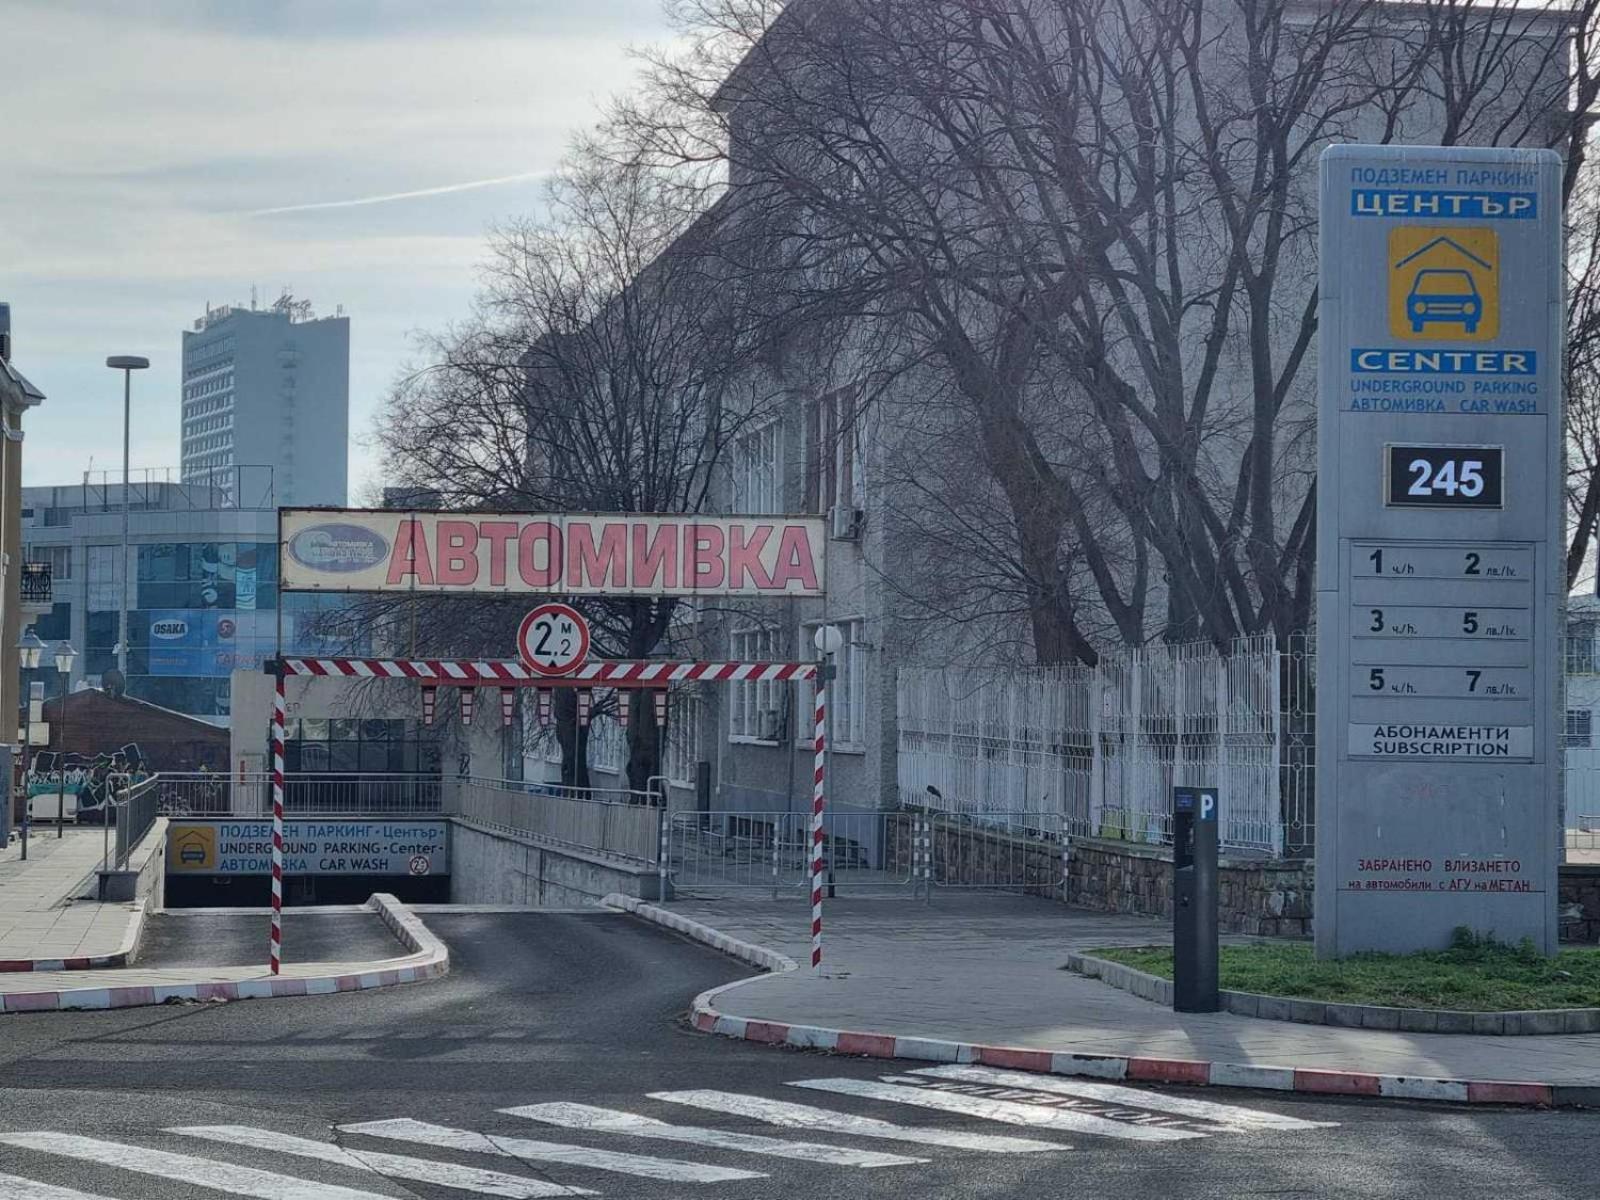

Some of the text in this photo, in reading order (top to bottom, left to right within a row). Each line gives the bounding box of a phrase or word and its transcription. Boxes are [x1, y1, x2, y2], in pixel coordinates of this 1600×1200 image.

[1351, 167, 1538, 186] ПОДЗЕМЕН ПАРКИНГ
[1357, 193, 1531, 215] ЦЕНТЪР
[1358, 351, 1528, 371] CENTER
[1351, 379, 1537, 394] UNDERGROUND PARKING
[1351, 398, 1445, 411] АВТОМИВКА
[1460, 399, 1537, 412] CAR WASH
[1407, 459, 1484, 497] 245
[385, 519, 818, 590] АВТОМИВКА
[1370, 549, 1382, 573] 1
[1464, 553, 1480, 574] 2
[154, 623, 185, 634] OSAKA
[1370, 609, 1384, 632] 3
[1463, 612, 1478, 634] 5
[1370, 668, 1384, 690] 5
[1466, 670, 1482, 691] 7
[1373, 725, 1509, 741] АБОНАМЕНТИ
[1373, 741, 1509, 755] SUBSCRIPTION
[1201, 793, 1214, 820] P
[220, 842, 317, 854] UNDERGOUND
[220, 858, 307, 870] АВТОМВКА
[319, 858, 388, 870] CAR WASH
[1358, 859, 1521, 873] ЗАБРАНЕНО ВЛИЗАНЕТО
[1349, 880, 1361, 889] на
[1365, 878, 1432, 890] автомобили
[1450, 878, 1471, 890] АГУ
[1488, 879, 1531, 892] МЕТАН
